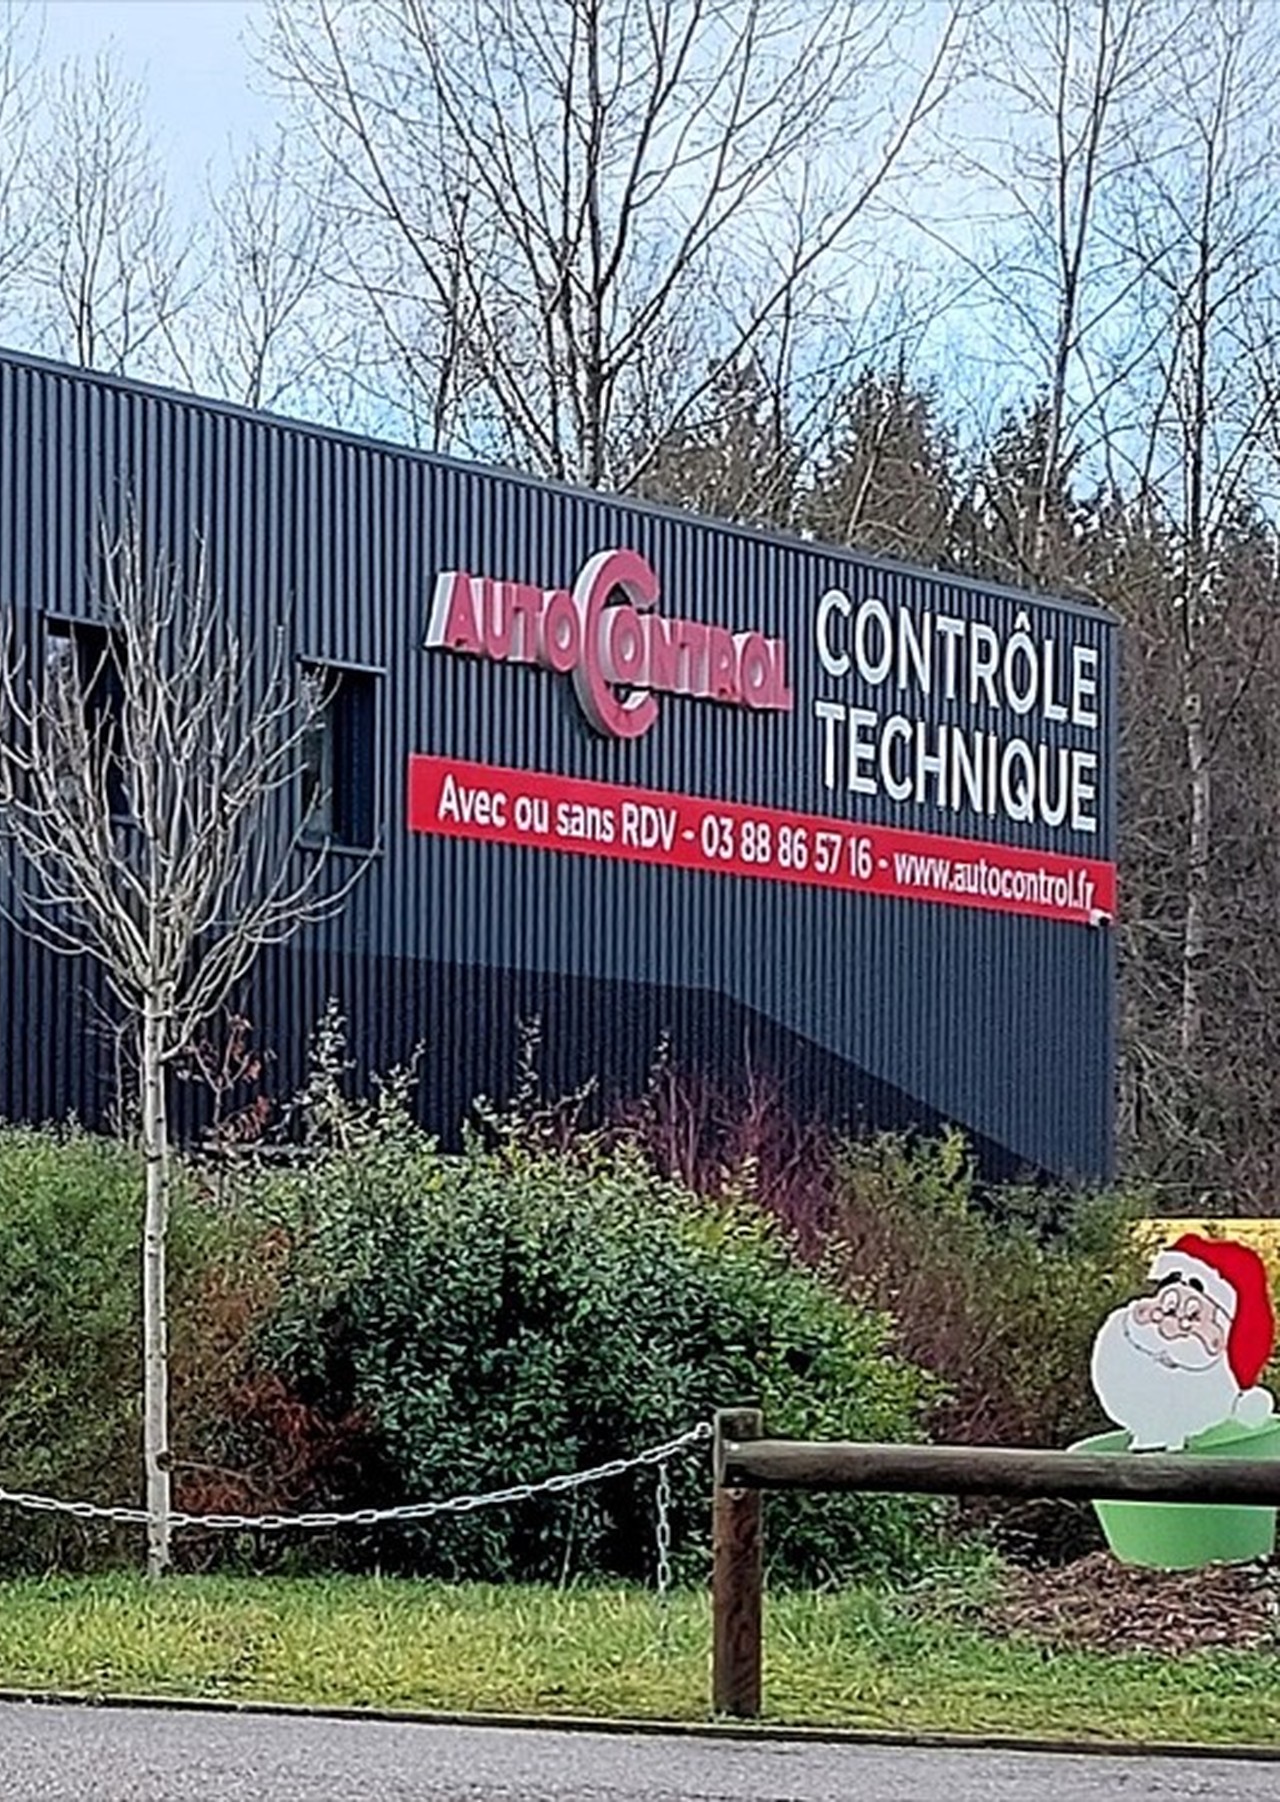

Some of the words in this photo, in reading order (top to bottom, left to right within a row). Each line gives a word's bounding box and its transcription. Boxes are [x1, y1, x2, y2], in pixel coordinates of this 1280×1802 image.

[425, 548, 794, 738] AUTOCONTROL
[816, 589, 1098, 729] CONTRÔLE
[815, 699, 1097, 832] TECHNIQUE
[438, 774, 506, 827] Avec
[514, 796, 549, 833] ou
[556, 801, 614, 843] sans
[622, 802, 677, 851] RDV
[701, 814, 733, 858] 03
[740, 820, 771, 863] 88
[777, 826, 808, 869] 86
[814, 831, 841, 875] 57
[848, 836, 872, 879] 16
[892, 851, 1095, 911] www.autocontrol.fr
